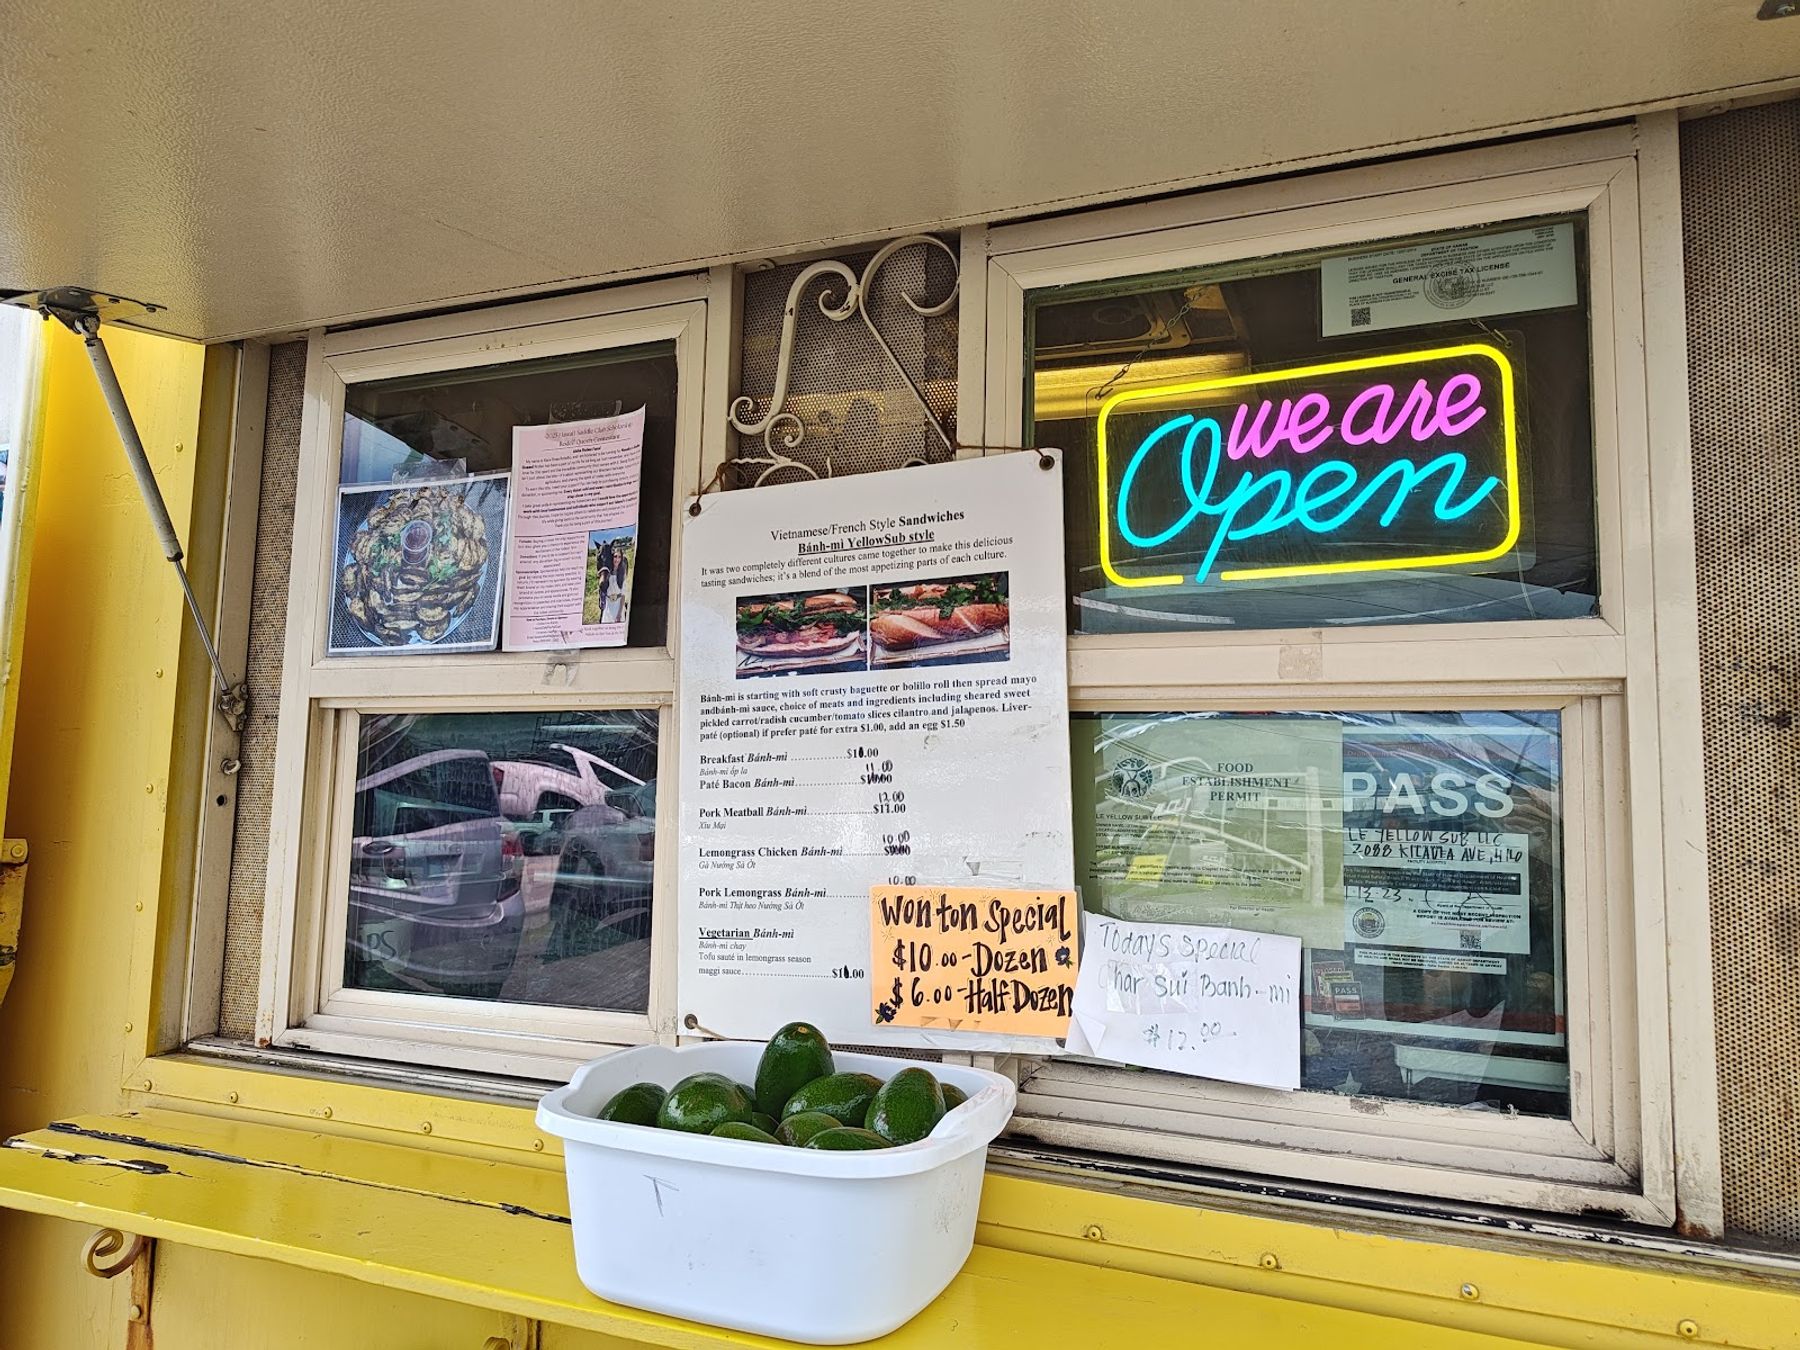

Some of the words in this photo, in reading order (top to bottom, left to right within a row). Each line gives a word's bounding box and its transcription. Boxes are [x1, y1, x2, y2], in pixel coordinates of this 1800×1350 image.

[1392, 274, 1428, 284] GENERAL
[1430, 270, 1458, 278] EXCISE
[1477, 262, 1510, 272] LICENSE
[1227, 393, 1334, 460] we
[1340, 373, 1487, 446] are
[1117, 414, 1500, 584] Open
[870, 518, 896, 532] Style
[899, 510, 965, 527] Sandwiches
[848, 532, 906, 548] YellowSub
[909, 529, 934, 542] style
[702, 568, 707, 576] It
[726, 566, 741, 574] two
[742, 560, 786, 573] completely
[788, 557, 822, 568] different
[824, 554, 856, 564] cultures
[858, 552, 880, 561] came
[882, 547, 917, 560] together
[918, 546, 927, 554] to
[929, 543, 953, 553] make
[955, 541, 971, 550] this
[973, 537, 1013, 548] delicious
[701, 578, 727, 588] tasting
[799, 568, 822, 579] blend
[823, 567, 834, 576] of
[834, 566, 847, 575] the
[849, 565, 869, 574] most
[871, 560, 915, 574] appetizing
[917, 558, 938, 570] parts
[940, 554, 951, 565] of
[951, 553, 971, 564] each
[738, 693, 745, 701] is
[746, 691, 780, 701] starting
[782, 689, 800, 698] with
[802, 688, 818, 697] soft
[820, 688, 847, 697] crusty
[850, 685, 888, 696] baguette
[903, 681, 931, 691] bolillo
[934, 680, 950, 689] roll
[952, 679, 972, 688] then
[976, 676, 1007, 689] spread
[1011, 676, 1037, 686] mayo
[780, 702, 807, 711] choice
[808, 700, 818, 709] of
[820, 700, 845, 709] meats
[847, 698, 864, 707] and
[866, 696, 916, 707] ingredients
[918, 692, 962, 703] including
[964, 690, 1001, 701] sheared
[1004, 690, 1030, 698] sweet
[700, 718, 730, 730] pickled
[732, 715, 787, 726] carrot/radish
[789, 712, 866, 723] cucumber/tomato
[868, 710, 891, 719] slices
[893, 709, 929, 718] cilantro
[932, 706, 949, 716] and
[720, 729, 760, 741] (optional)
[762, 728, 769, 737] if
[770, 727, 797, 739] prefer
[820, 726, 833, 734] for
[835, 726, 858, 734] extra
[889, 722, 906, 731] add
[922, 722, 938, 731] egg
[941, 719, 966, 729] $1.50
[700, 754, 744, 764] Breakfast
[1218, 762, 1253, 773] FOOD
[723, 780, 751, 789] Bacon
[1182, 776, 1291, 788] ESTABLISHMENT
[1210, 792, 1261, 802] PERMIT
[1344, 772, 1514, 818] PASS
[700, 808, 721, 818] Pork
[724, 807, 764, 817] Meatball
[1376, 830, 1433, 843] YELLOW
[700, 848, 755, 859] Lemongrass
[758, 847, 798, 857] Chicken
[700, 888, 722, 897] Pork
[724, 888, 782, 900] Lemongrass
[984, 896, 1071, 944] Special
[699, 927, 750, 938] Vegetarian
[699, 952, 716, 961] Tofu
[737, 953, 744, 961] in
[746, 953, 786, 964] lemongrass
[699, 968, 720, 976] maggi
